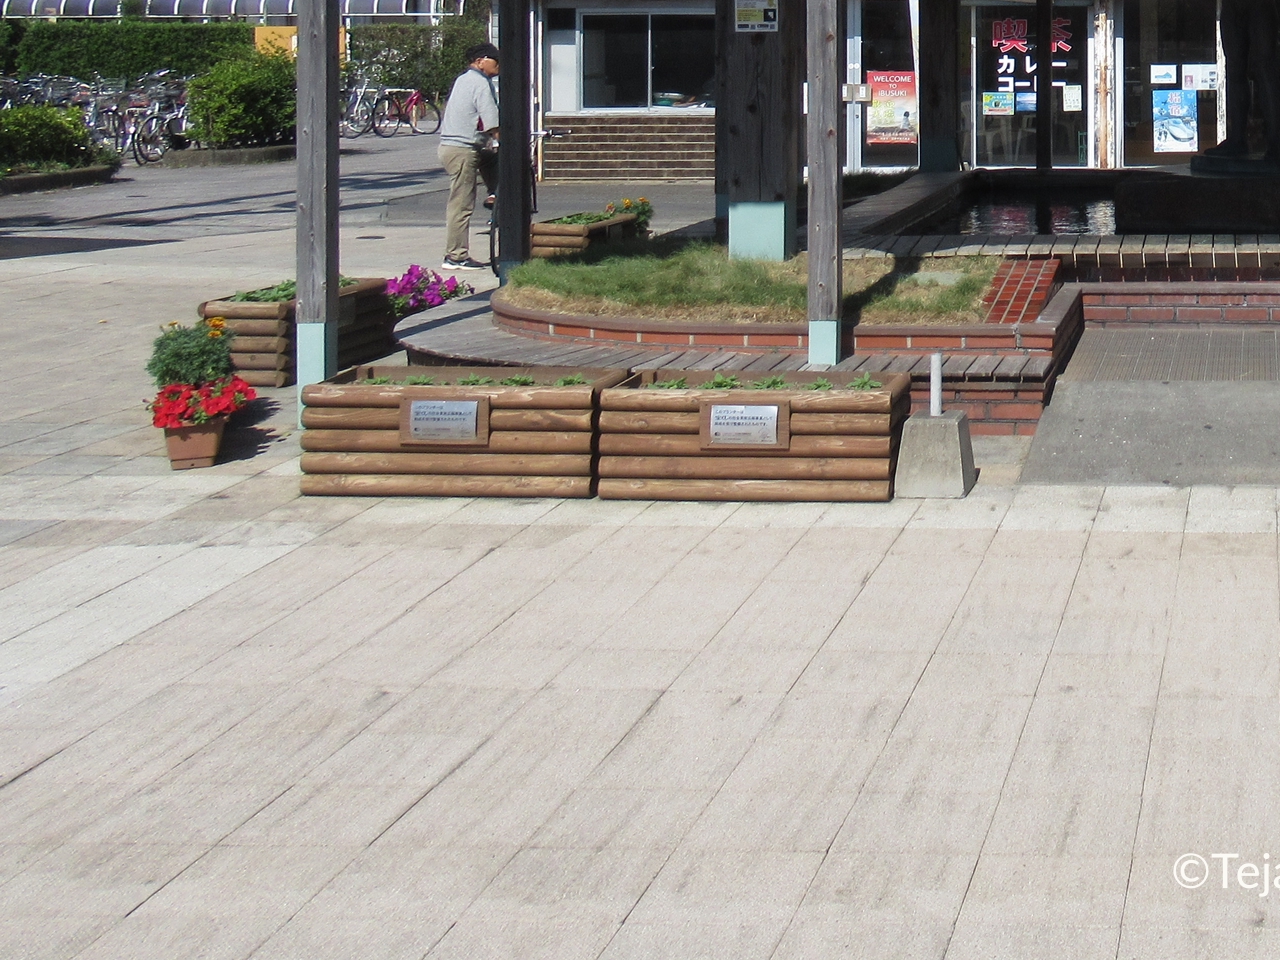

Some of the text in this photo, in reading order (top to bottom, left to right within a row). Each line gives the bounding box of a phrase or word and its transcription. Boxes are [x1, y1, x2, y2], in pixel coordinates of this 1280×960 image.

[997, 54, 1067, 74] カレー
[997, 75, 1067, 92] コーー
